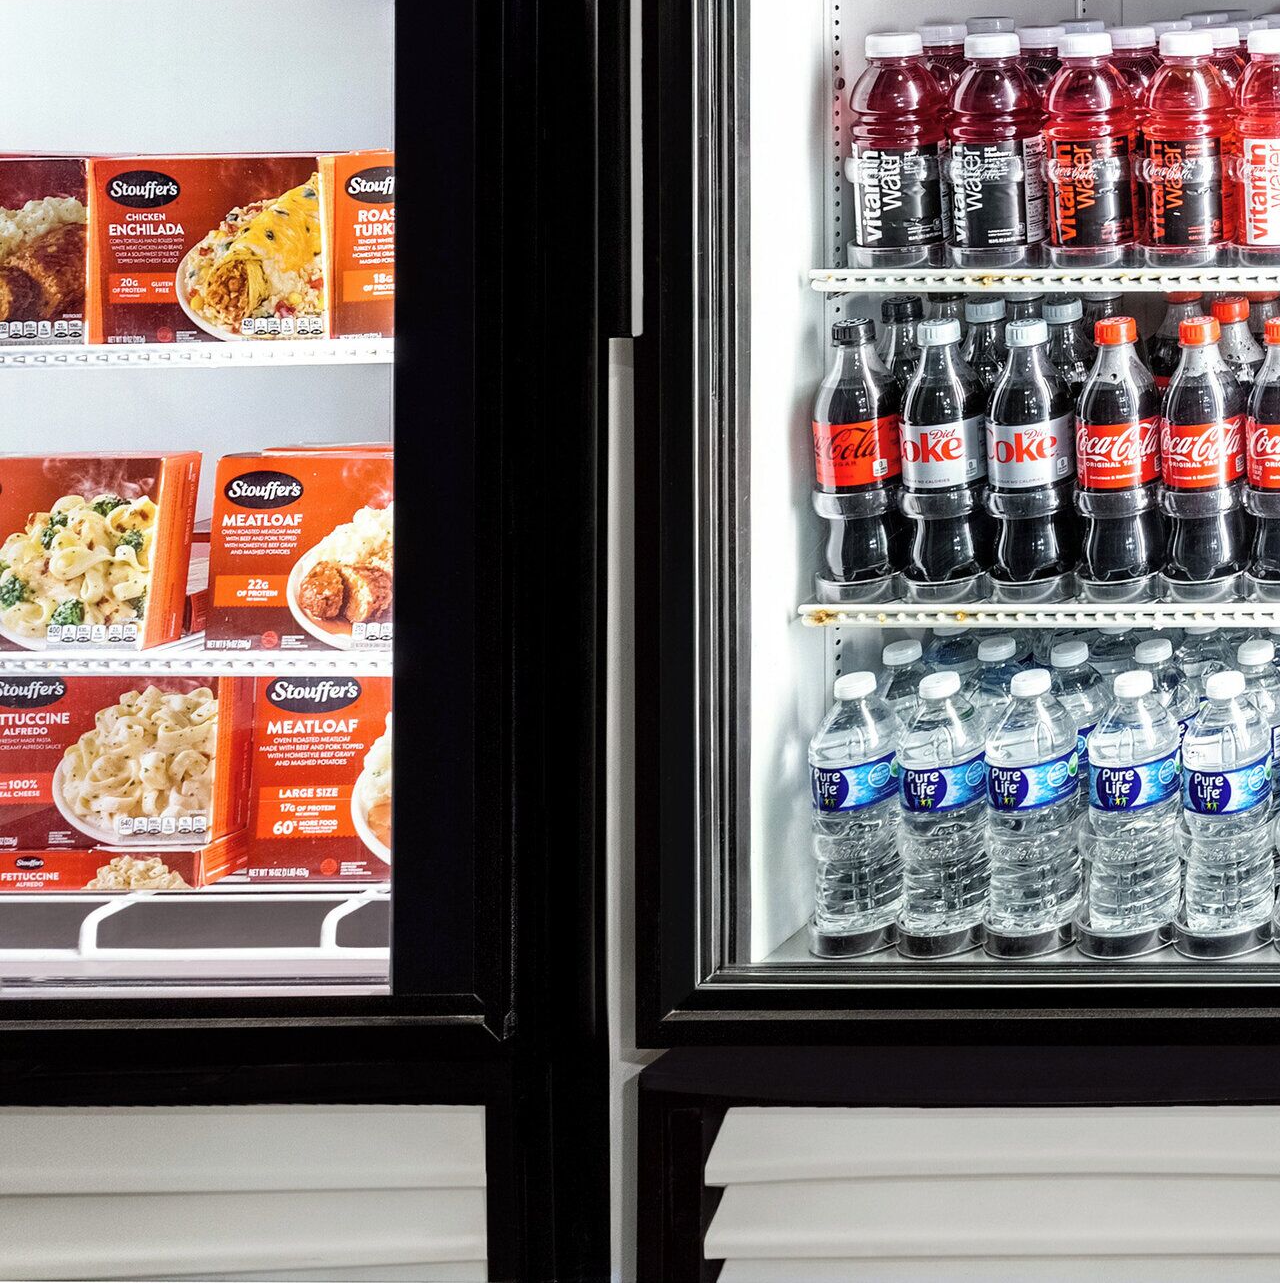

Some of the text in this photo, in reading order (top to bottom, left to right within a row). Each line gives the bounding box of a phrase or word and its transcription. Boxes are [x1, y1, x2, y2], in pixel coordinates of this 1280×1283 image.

[110, 181, 178, 199] Stouffer's
[1247, 143, 1269, 240] vitamin
[126, 213, 166, 221] CHICKEN
[109, 224, 184, 236] ENCHILADA
[121, 278, 138, 287] 20G
[930, 429, 955, 439] Diet
[1076, 422, 1159, 463] Coca-Cola
[1161, 421, 1240, 462] Coca-Cola
[229, 481, 302, 499] Stouffer's
[222, 514, 303, 527] MEATLOAF
[248, 579, 269, 589] 22G
[271, 681, 358, 703] Stouffer's
[3, 727, 48, 735] ALFREDO
[267, 719, 358, 734] MEATLOAF
[907, 770, 940, 783] Pure
[991, 769, 1021, 782] Pure
[1102, 769, 1134, 782] Pure
[1194, 775, 1223, 787] Pure
[9, 779, 37, 789] 100%
[911, 783, 938, 797] Life
[994, 781, 1019, 797] Life
[1106, 781, 1132, 797] Life
[279, 787, 338, 798] LARGE SIZE
[1, 872, 59, 881] FETTUCCINE
